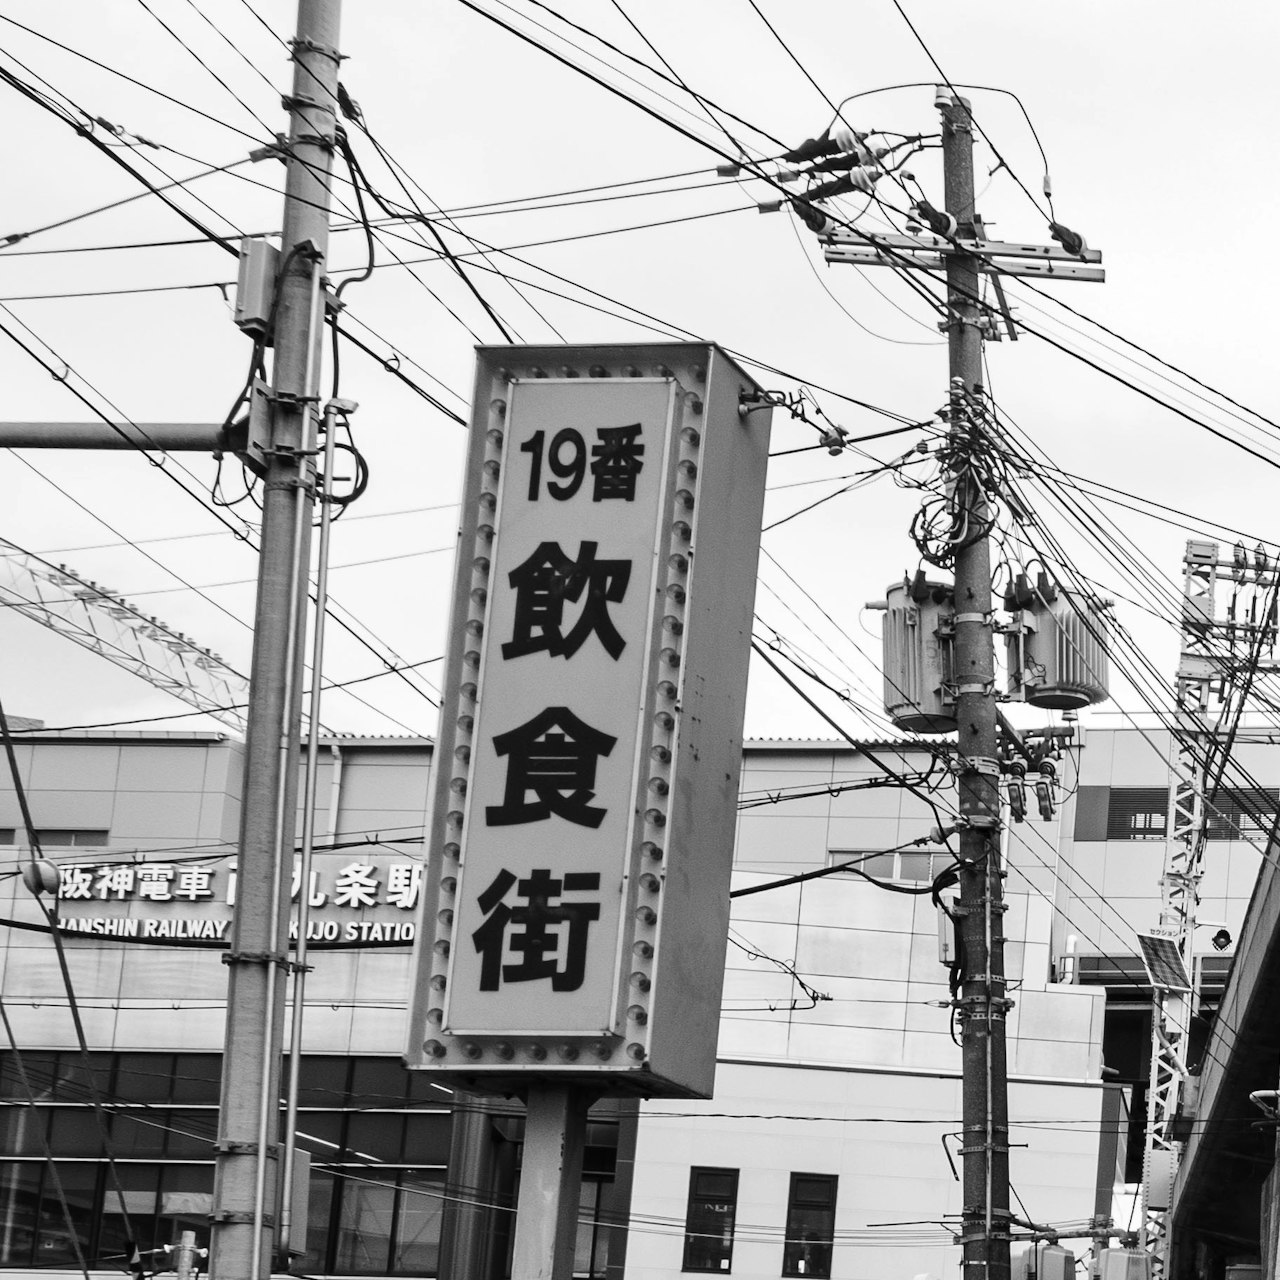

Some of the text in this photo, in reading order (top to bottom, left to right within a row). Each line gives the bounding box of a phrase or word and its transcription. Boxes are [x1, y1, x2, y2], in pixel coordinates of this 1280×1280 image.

[520, 422, 645, 502] 19番
[472, 540, 632, 993] 飲食街
[144, 918, 229, 939] RAILWAY
[344, 921, 416, 942] STATIO
